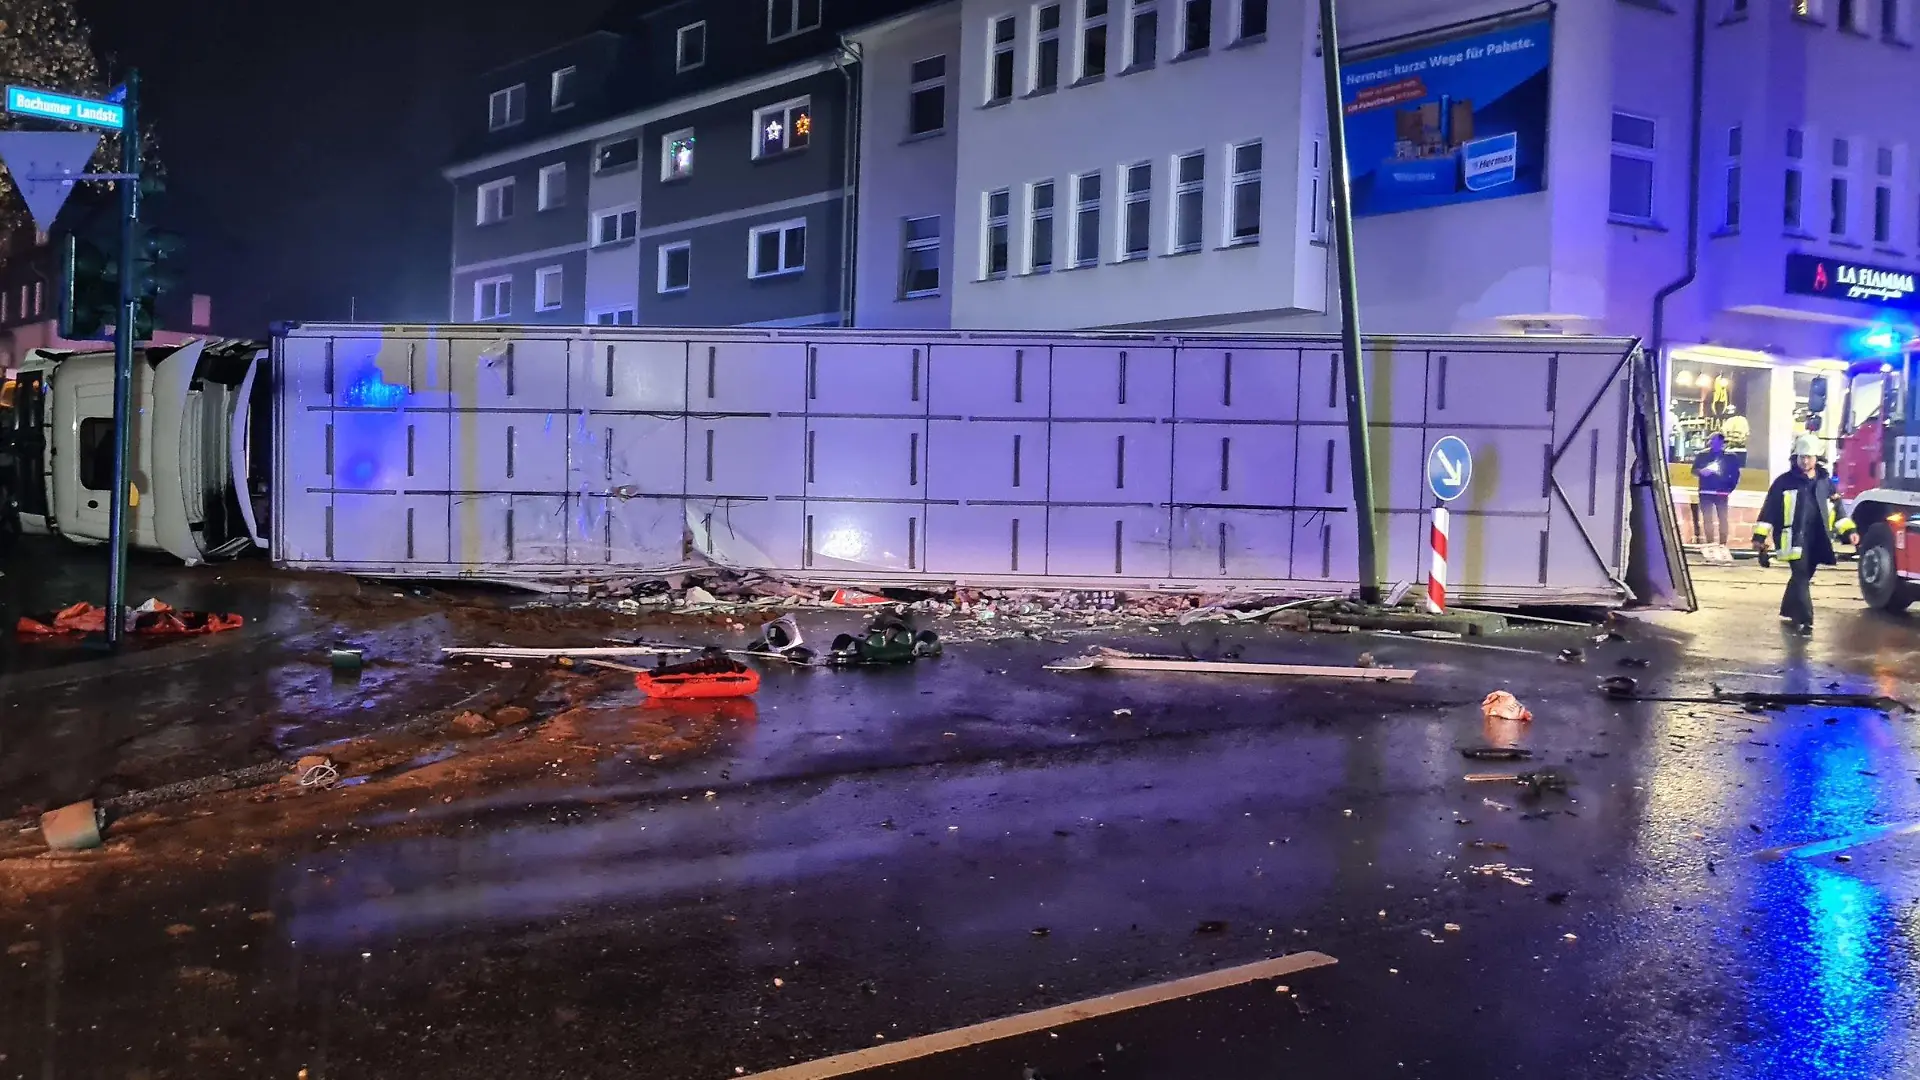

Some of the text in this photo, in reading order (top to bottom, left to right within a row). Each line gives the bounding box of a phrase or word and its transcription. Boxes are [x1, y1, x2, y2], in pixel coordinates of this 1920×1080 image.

[1346, 38, 1535, 85] Hermes: kurze Wege für Pakete.
[16, 93, 120, 123] Bochumer Landstr.
[1479, 154, 1514, 169] Hermes
[1837, 265, 1857, 284] LA
[1858, 268, 1915, 293] FIAMMA
[1894, 435, 1920, 478] FE
